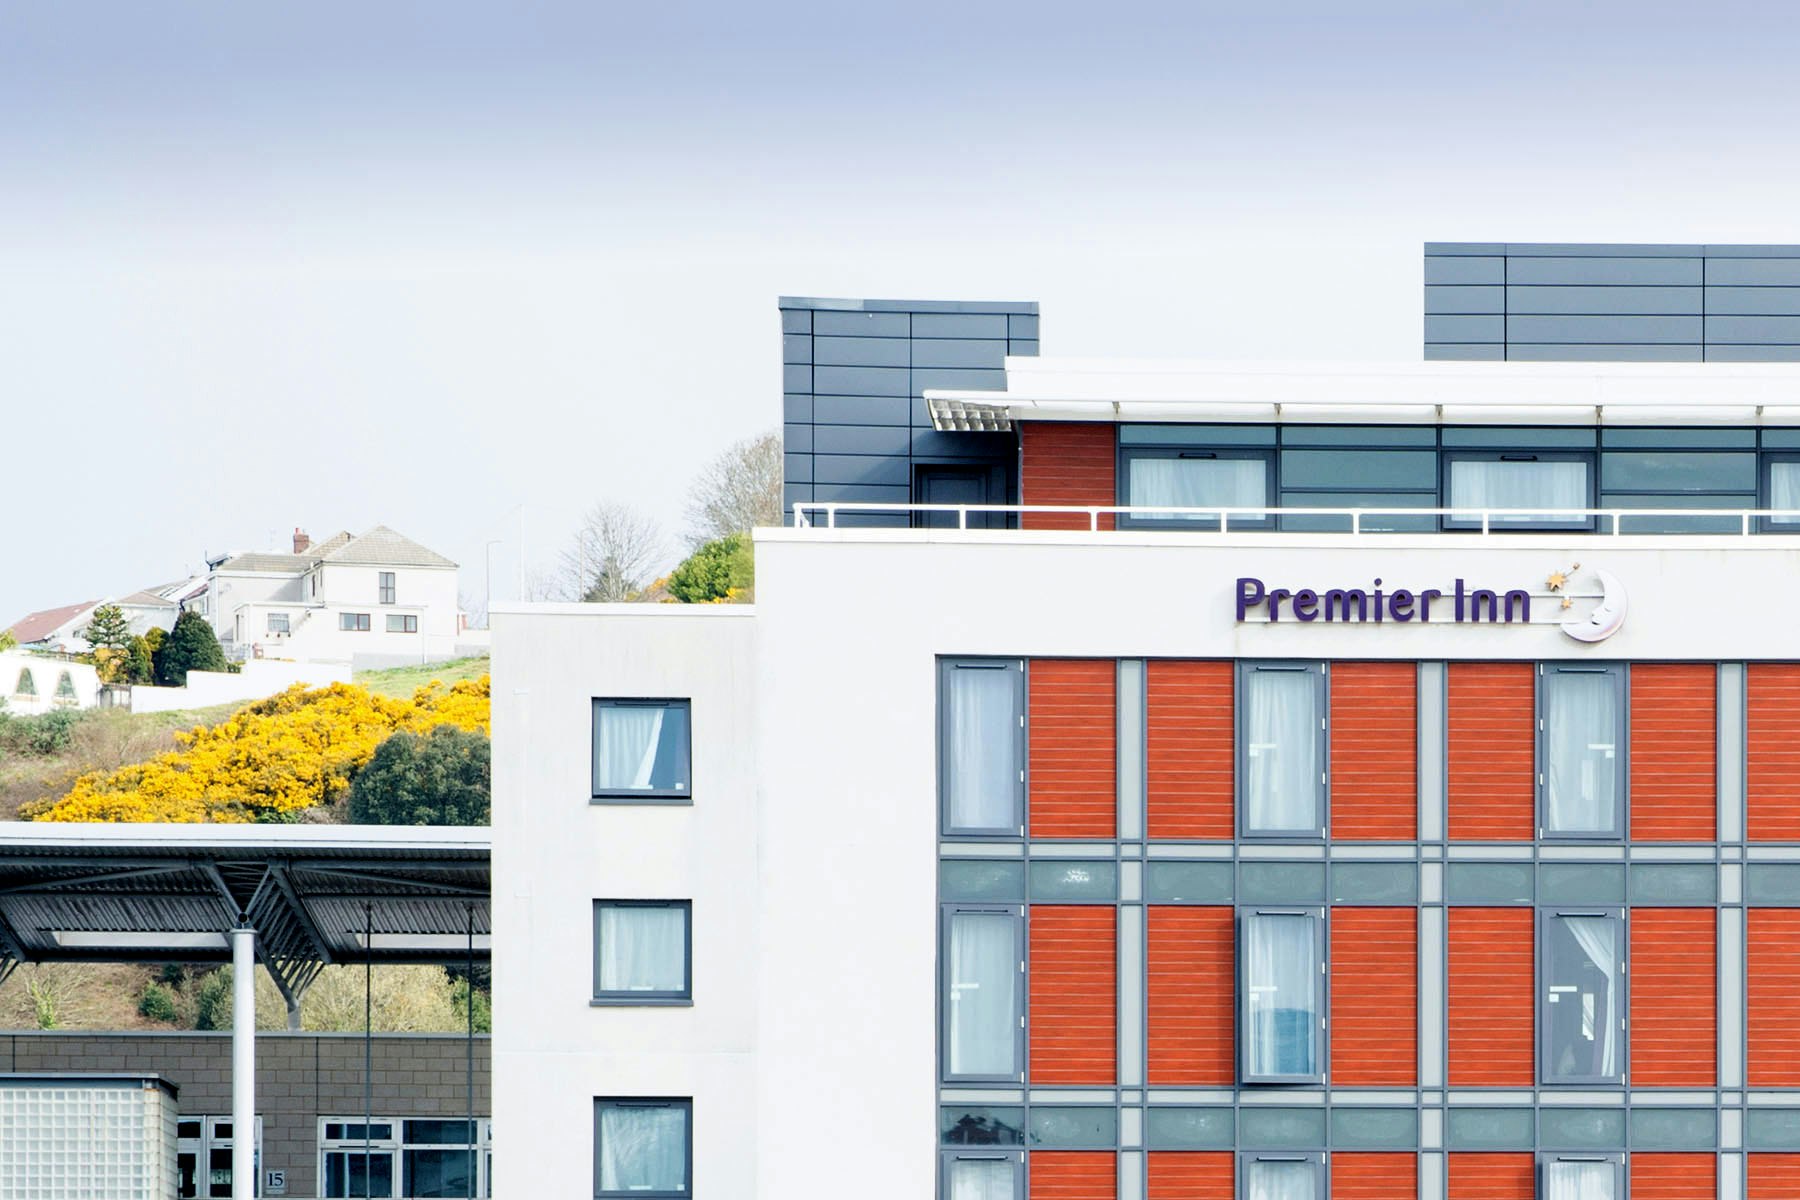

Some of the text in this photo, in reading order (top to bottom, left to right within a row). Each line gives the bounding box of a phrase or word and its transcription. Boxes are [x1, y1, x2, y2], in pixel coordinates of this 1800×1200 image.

[1236, 577, 1530, 622] Premier Inn
[268, 1172, 284, 1186] 15
